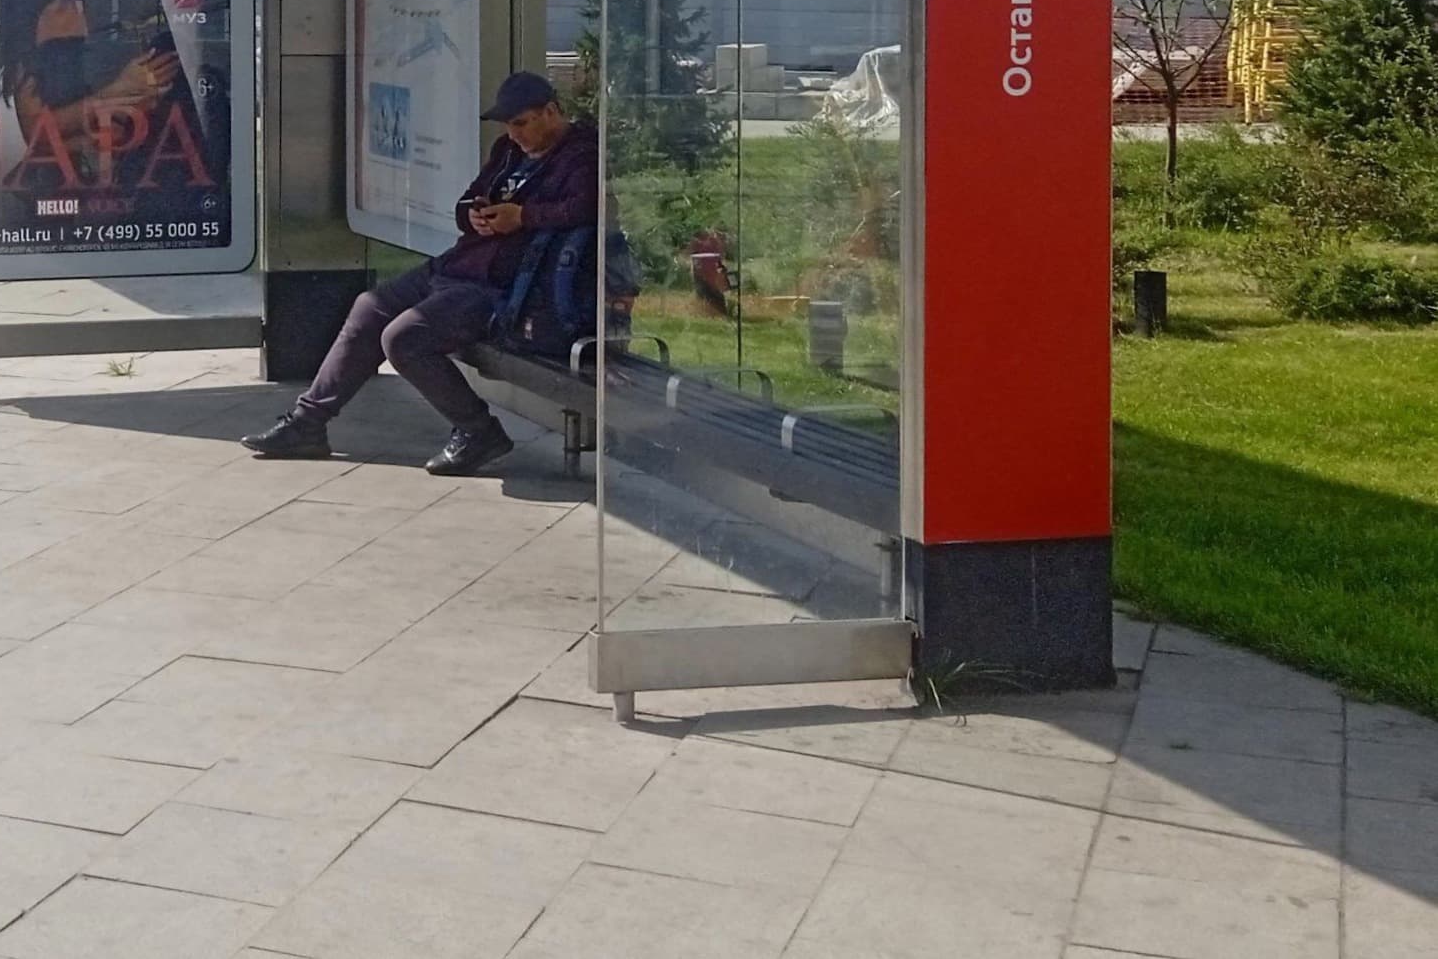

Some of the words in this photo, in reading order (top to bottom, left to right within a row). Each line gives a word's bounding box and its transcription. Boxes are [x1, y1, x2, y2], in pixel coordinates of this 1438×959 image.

[37, 199, 79, 215] HELLO!
[73, 226, 92, 240] +7
[97, 224, 140, 241] (499)
[145, 224, 163, 238] 55
[168, 223, 197, 237] 000
[202, 222, 219, 236] 55
